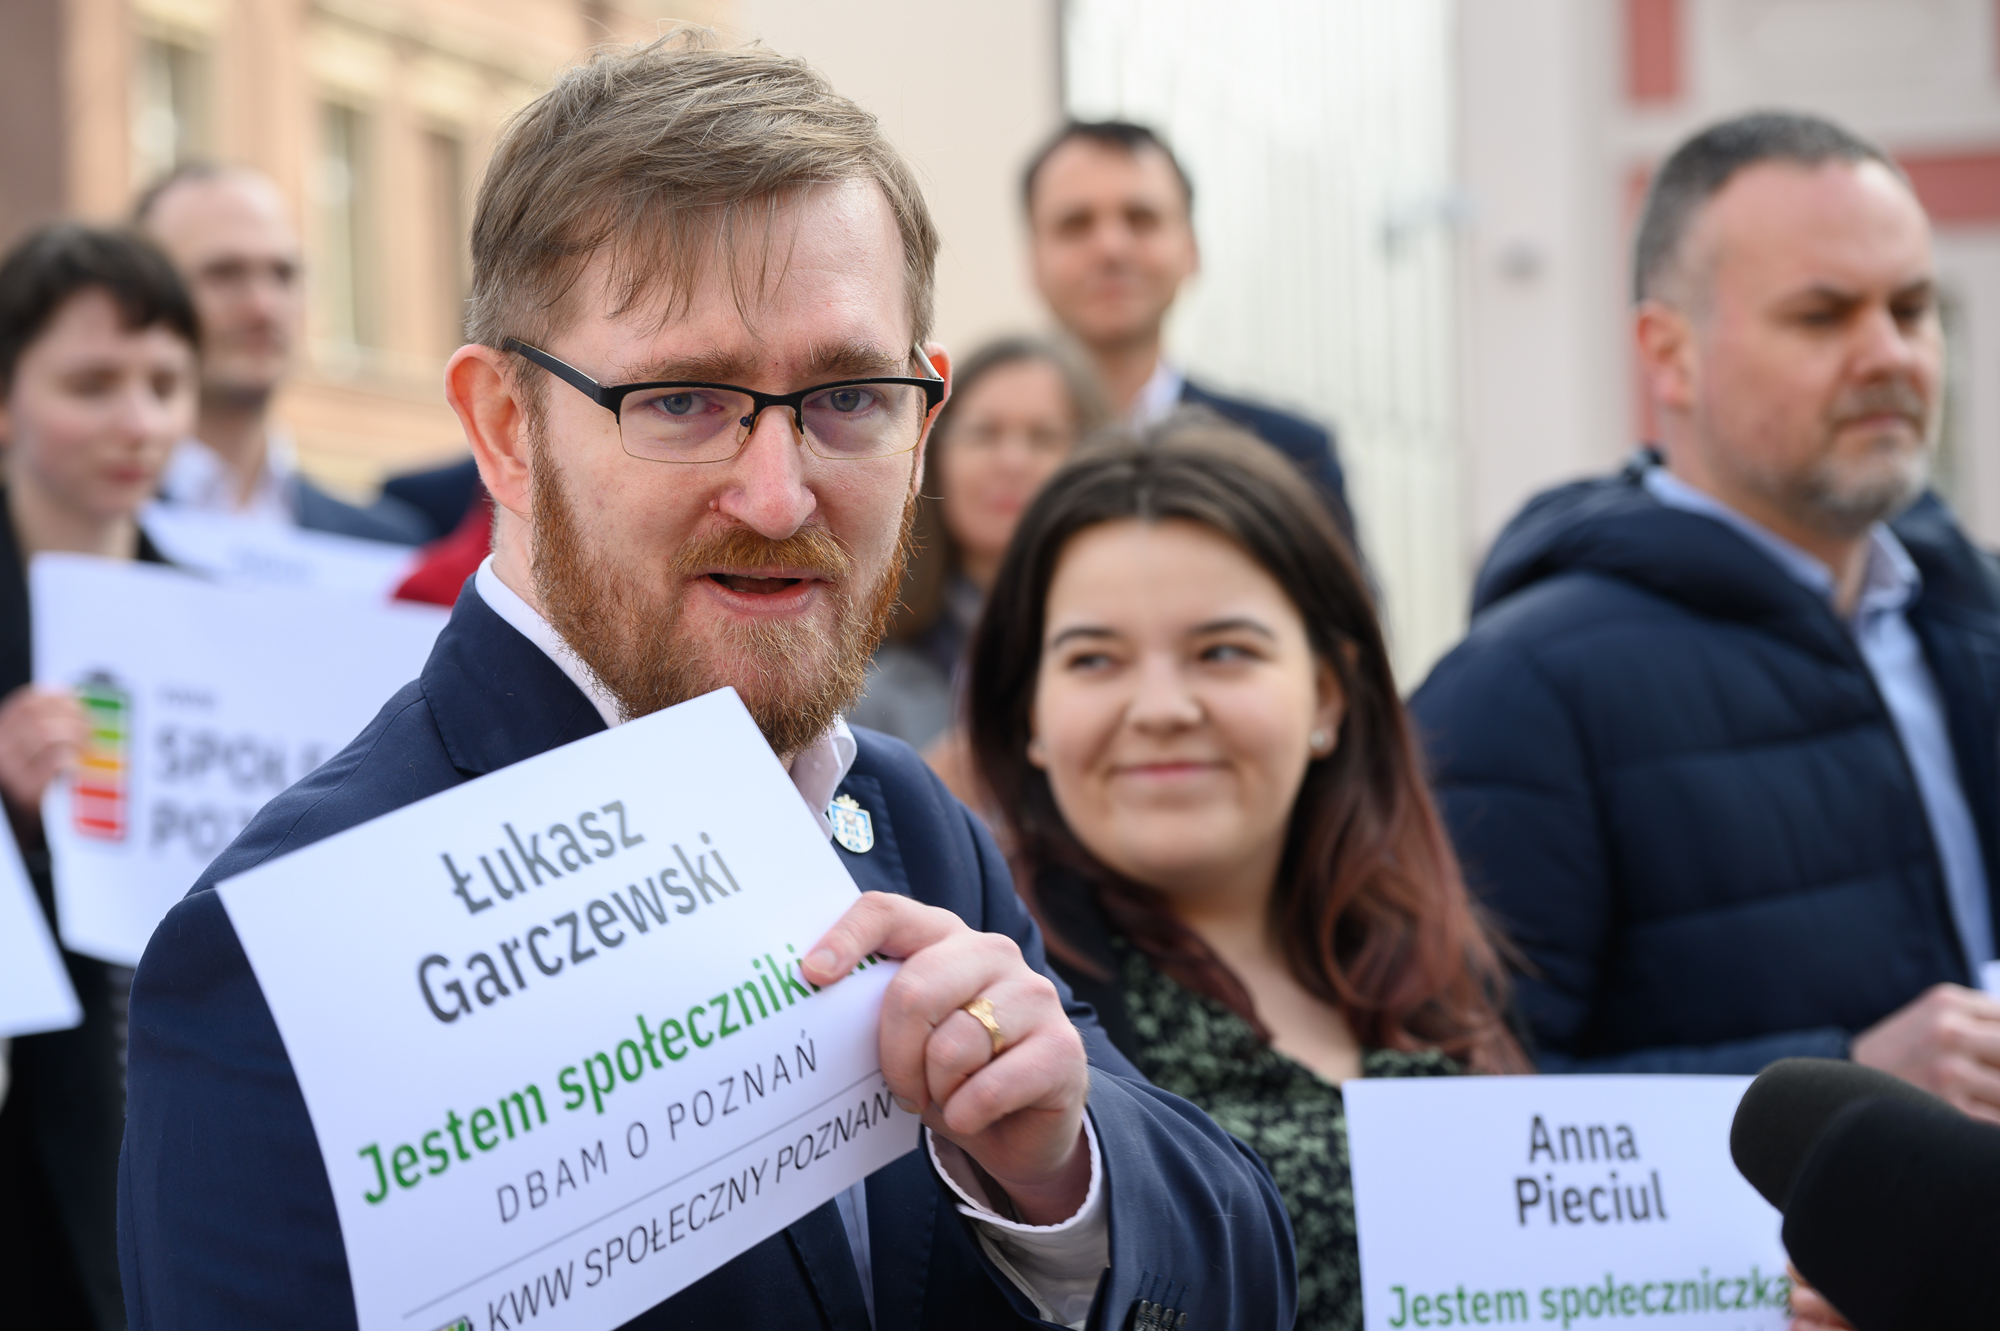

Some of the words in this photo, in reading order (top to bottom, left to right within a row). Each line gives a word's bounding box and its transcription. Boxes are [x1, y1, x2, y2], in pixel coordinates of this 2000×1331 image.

[418, 832, 741, 1023] Garczewski
[441, 800, 647, 915] Łukasz
[358, 1083, 548, 1206] Jestem
[558, 943, 888, 1115] społeczniki
[497, 1140, 607, 1224] DBAM
[626, 1121, 649, 1159] O
[667, 1029, 817, 1141] POZNAŃ
[1528, 1114, 1640, 1165] Anna
[488, 1260, 574, 1331] KWW
[585, 1157, 768, 1288] SPOŁECZNY
[776, 1081, 892, 1184] POZNAŃ
[1515, 1170, 1668, 1227] Pieciul
[1388, 1282, 1528, 1329] Jestem
